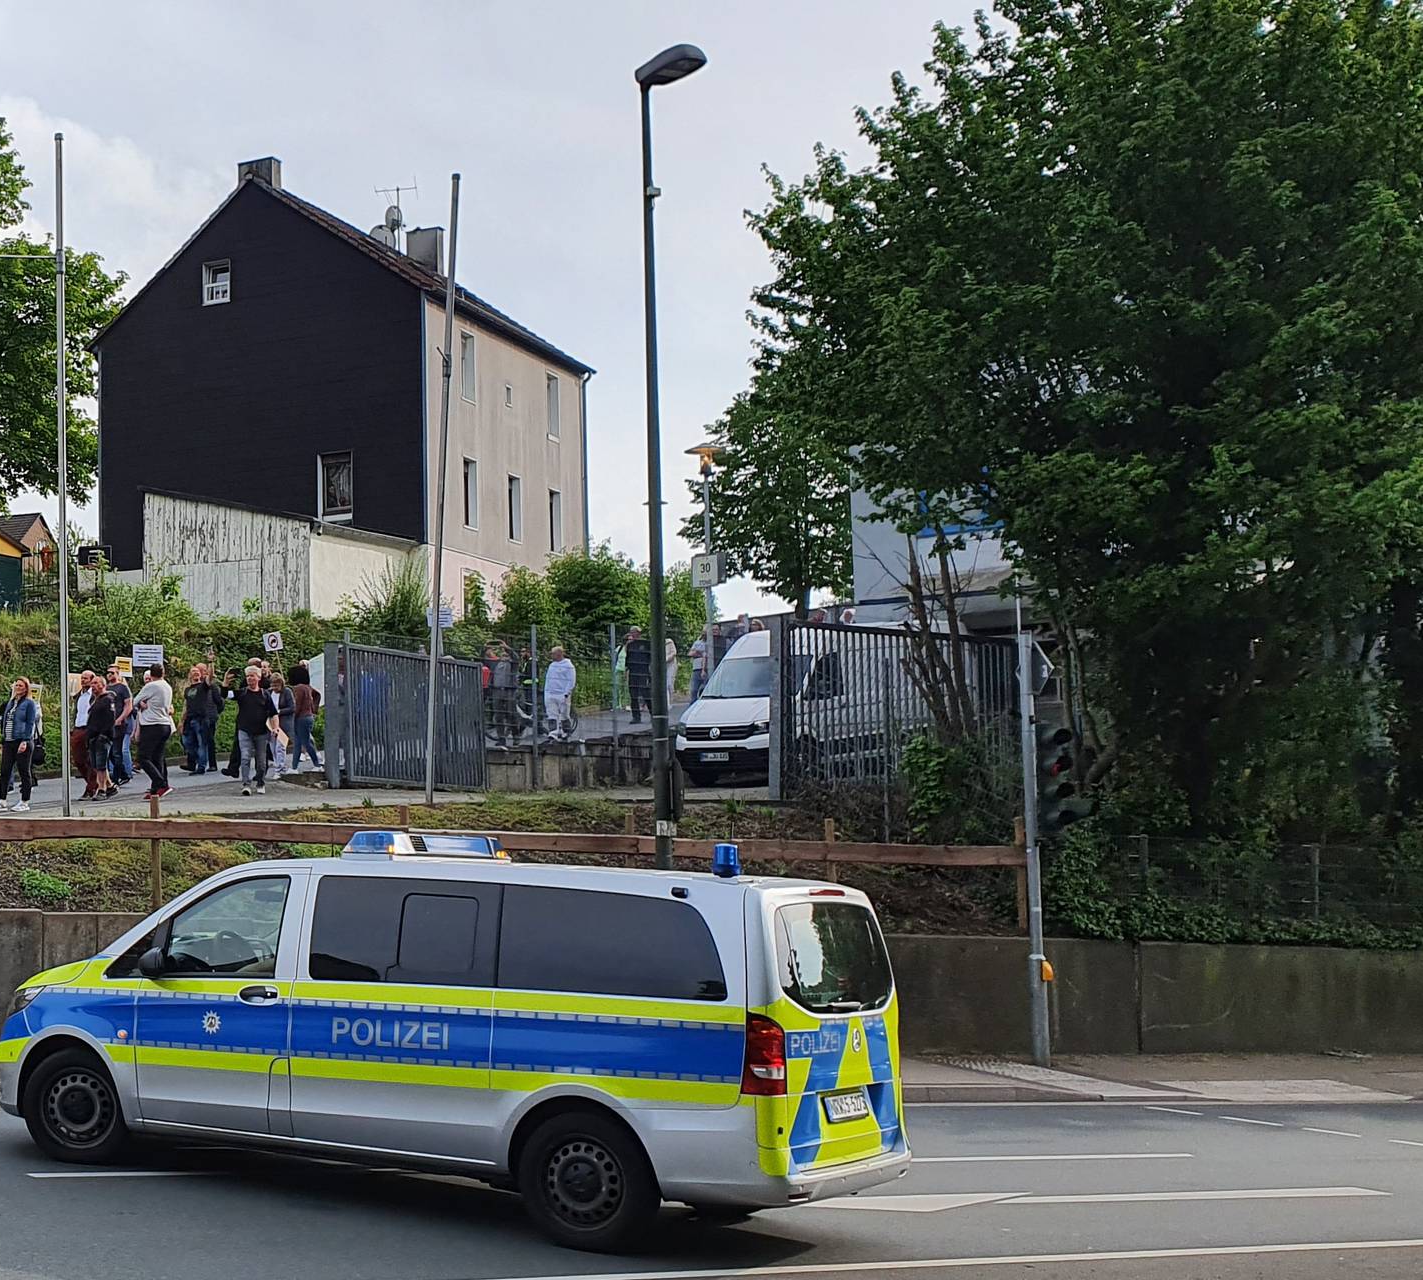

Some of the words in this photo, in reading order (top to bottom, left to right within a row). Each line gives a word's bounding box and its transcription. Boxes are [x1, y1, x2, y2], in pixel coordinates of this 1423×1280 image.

[700, 563, 711, 573] 30
[332, 1016, 449, 1050] POLIZEI
[790, 1031, 841, 1056] POLIZEI
